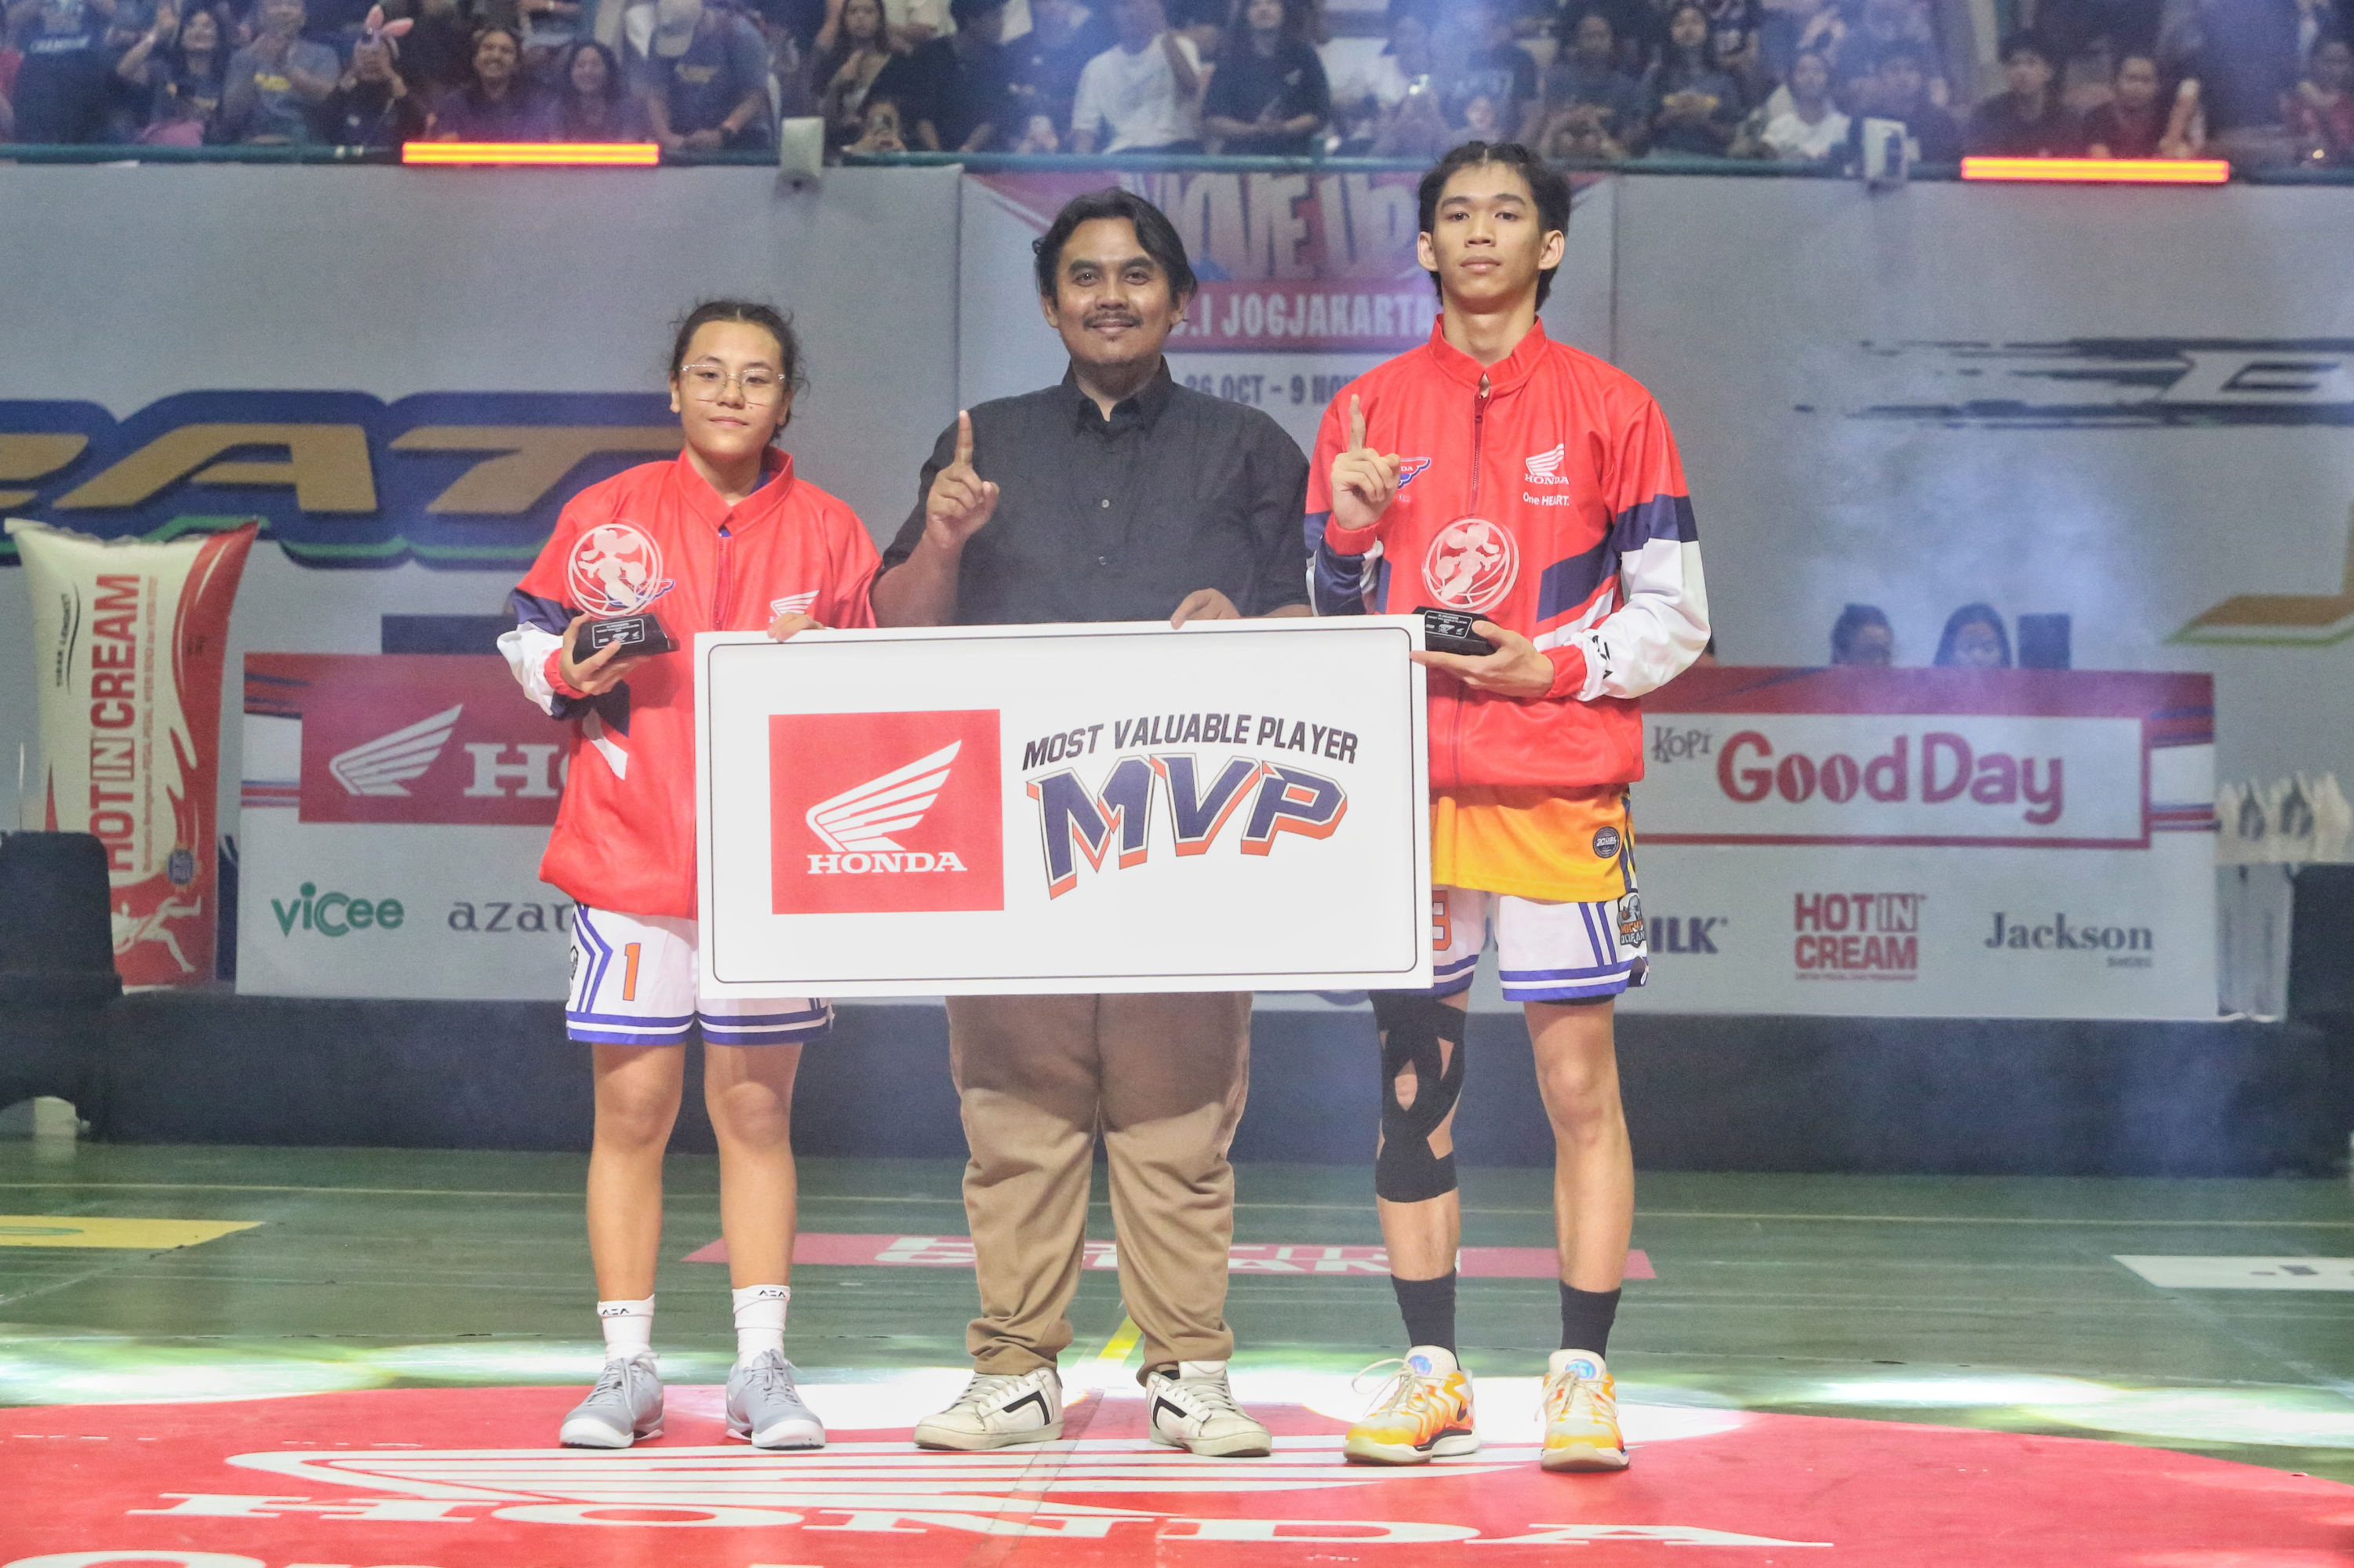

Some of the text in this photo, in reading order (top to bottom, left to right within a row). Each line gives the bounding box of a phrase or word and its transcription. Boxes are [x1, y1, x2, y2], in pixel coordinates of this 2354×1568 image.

[1221, 293, 1437, 338] JOGJAKARTA
[1290, 374, 1305, 405] 9
[1312, 374, 1359, 404] NO
[1525, 473, 1570, 485] HONDA
[1523, 493, 1570, 507] One HEART.
[89, 575, 140, 729] CREAM
[1022, 713, 1359, 771] MOST VALUABLE PLAYER
[1716, 730, 1907, 805] Good
[1921, 733, 2065, 825] Day
[1027, 752, 1348, 901] MVP
[806, 850, 968, 875] HONDA
[448, 900, 574, 933] azar
[1649, 916, 1719, 954] ILK
[1984, 911, 2154, 950] Jackson
[1795, 934, 1919, 970] CREAM
[623, 942, 642, 1002] 1
[125, 1492, 1836, 1548] HONDA
